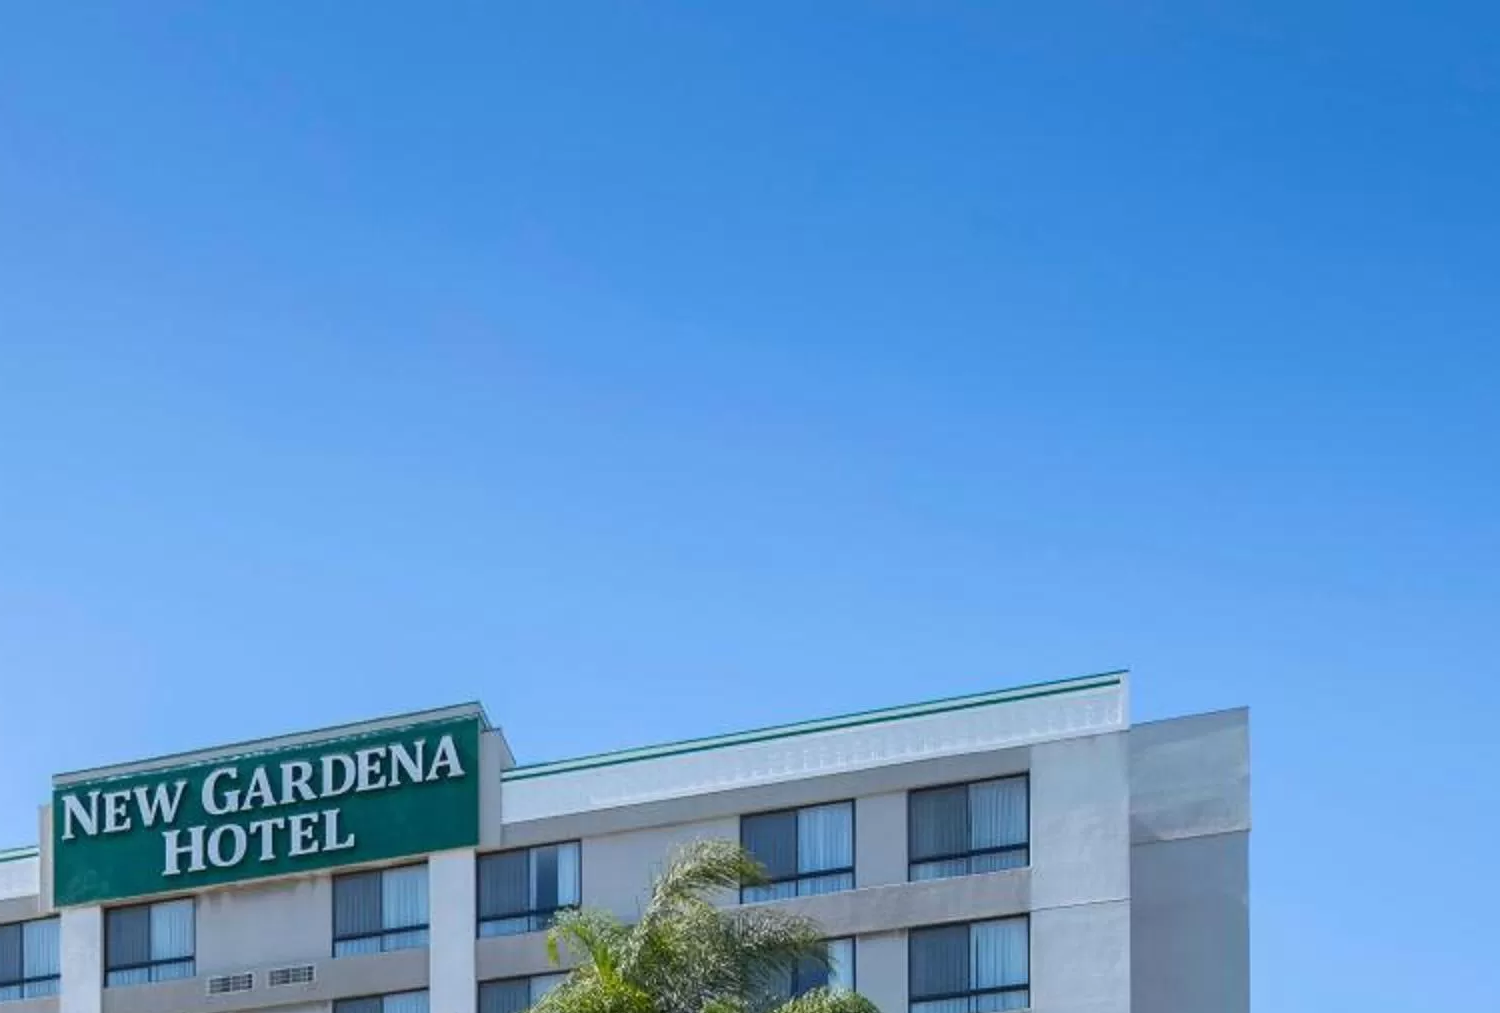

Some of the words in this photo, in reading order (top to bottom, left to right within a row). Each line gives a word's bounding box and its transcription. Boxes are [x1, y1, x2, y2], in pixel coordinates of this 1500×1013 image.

[61, 779, 188, 841] NEW
[201, 733, 465, 816] GARDENA
[161, 807, 356, 877] HOTEL
